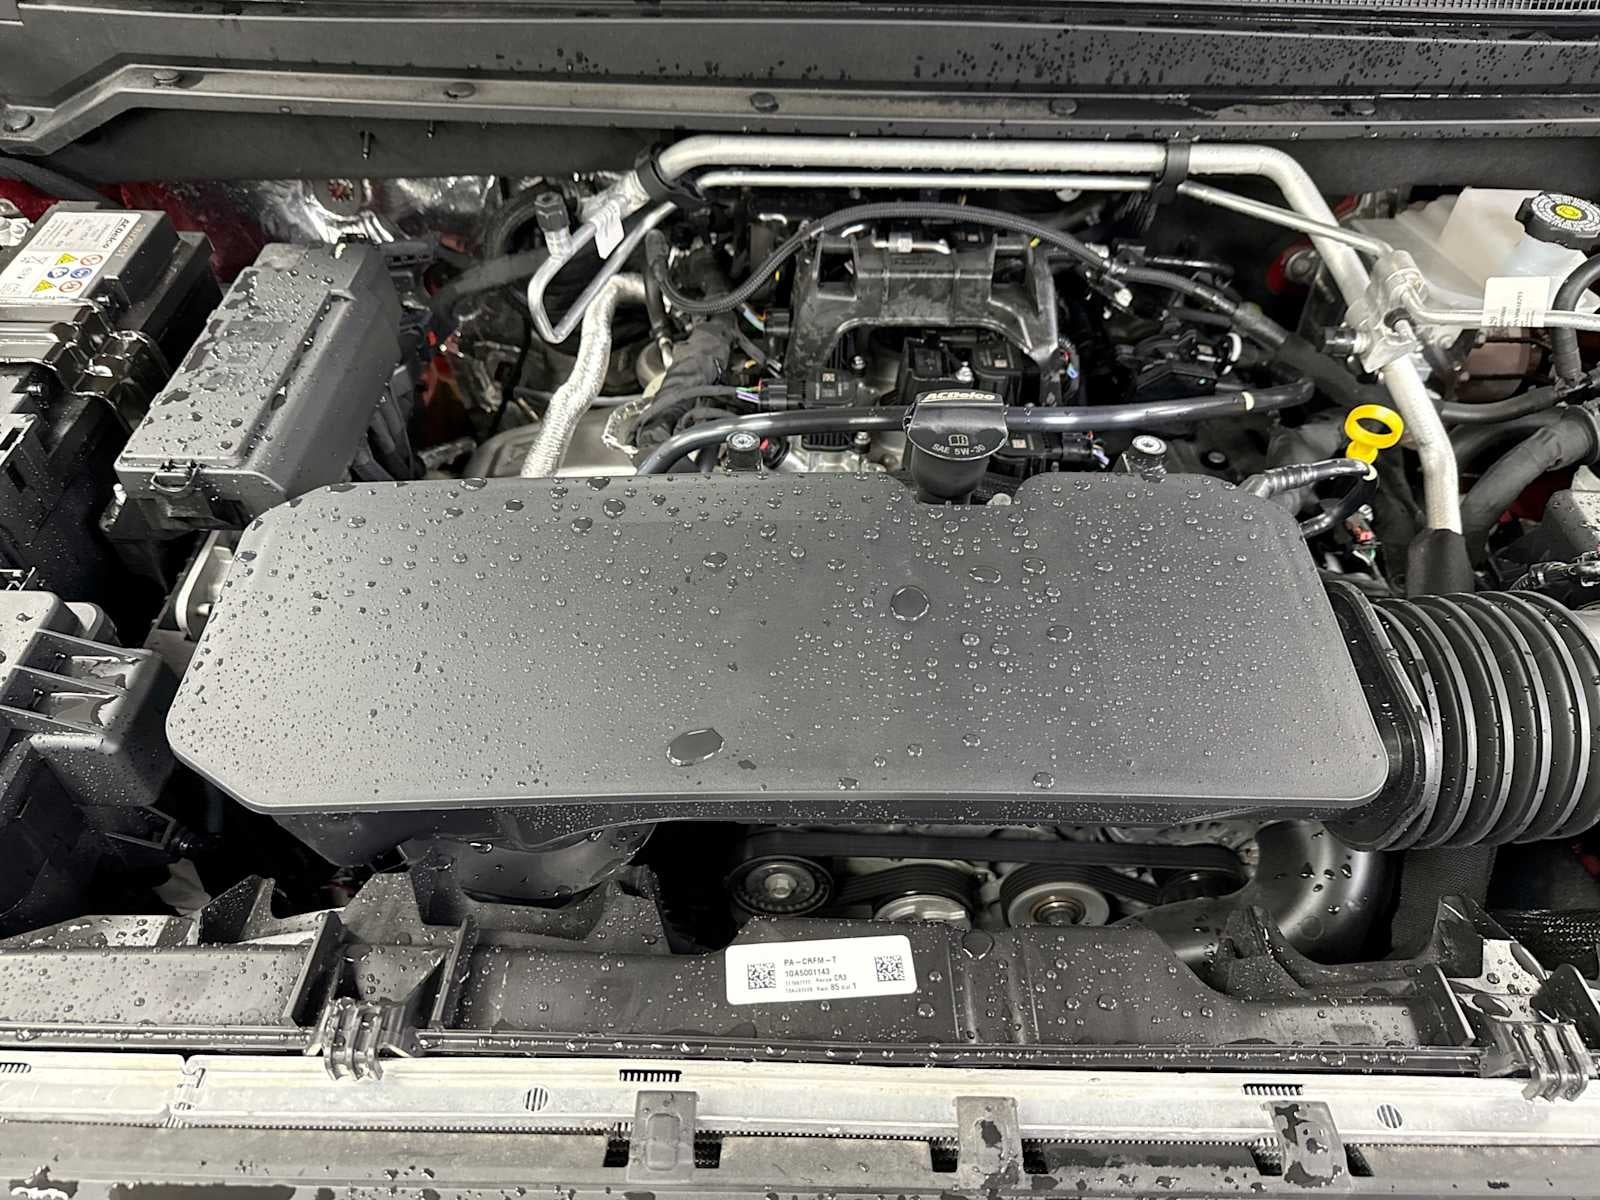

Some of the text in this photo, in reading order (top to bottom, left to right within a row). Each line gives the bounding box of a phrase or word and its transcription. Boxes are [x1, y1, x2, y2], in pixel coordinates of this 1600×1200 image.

[923, 391, 996, 401] ACDelco
[931, 443, 987, 456] SAE 5W-30
